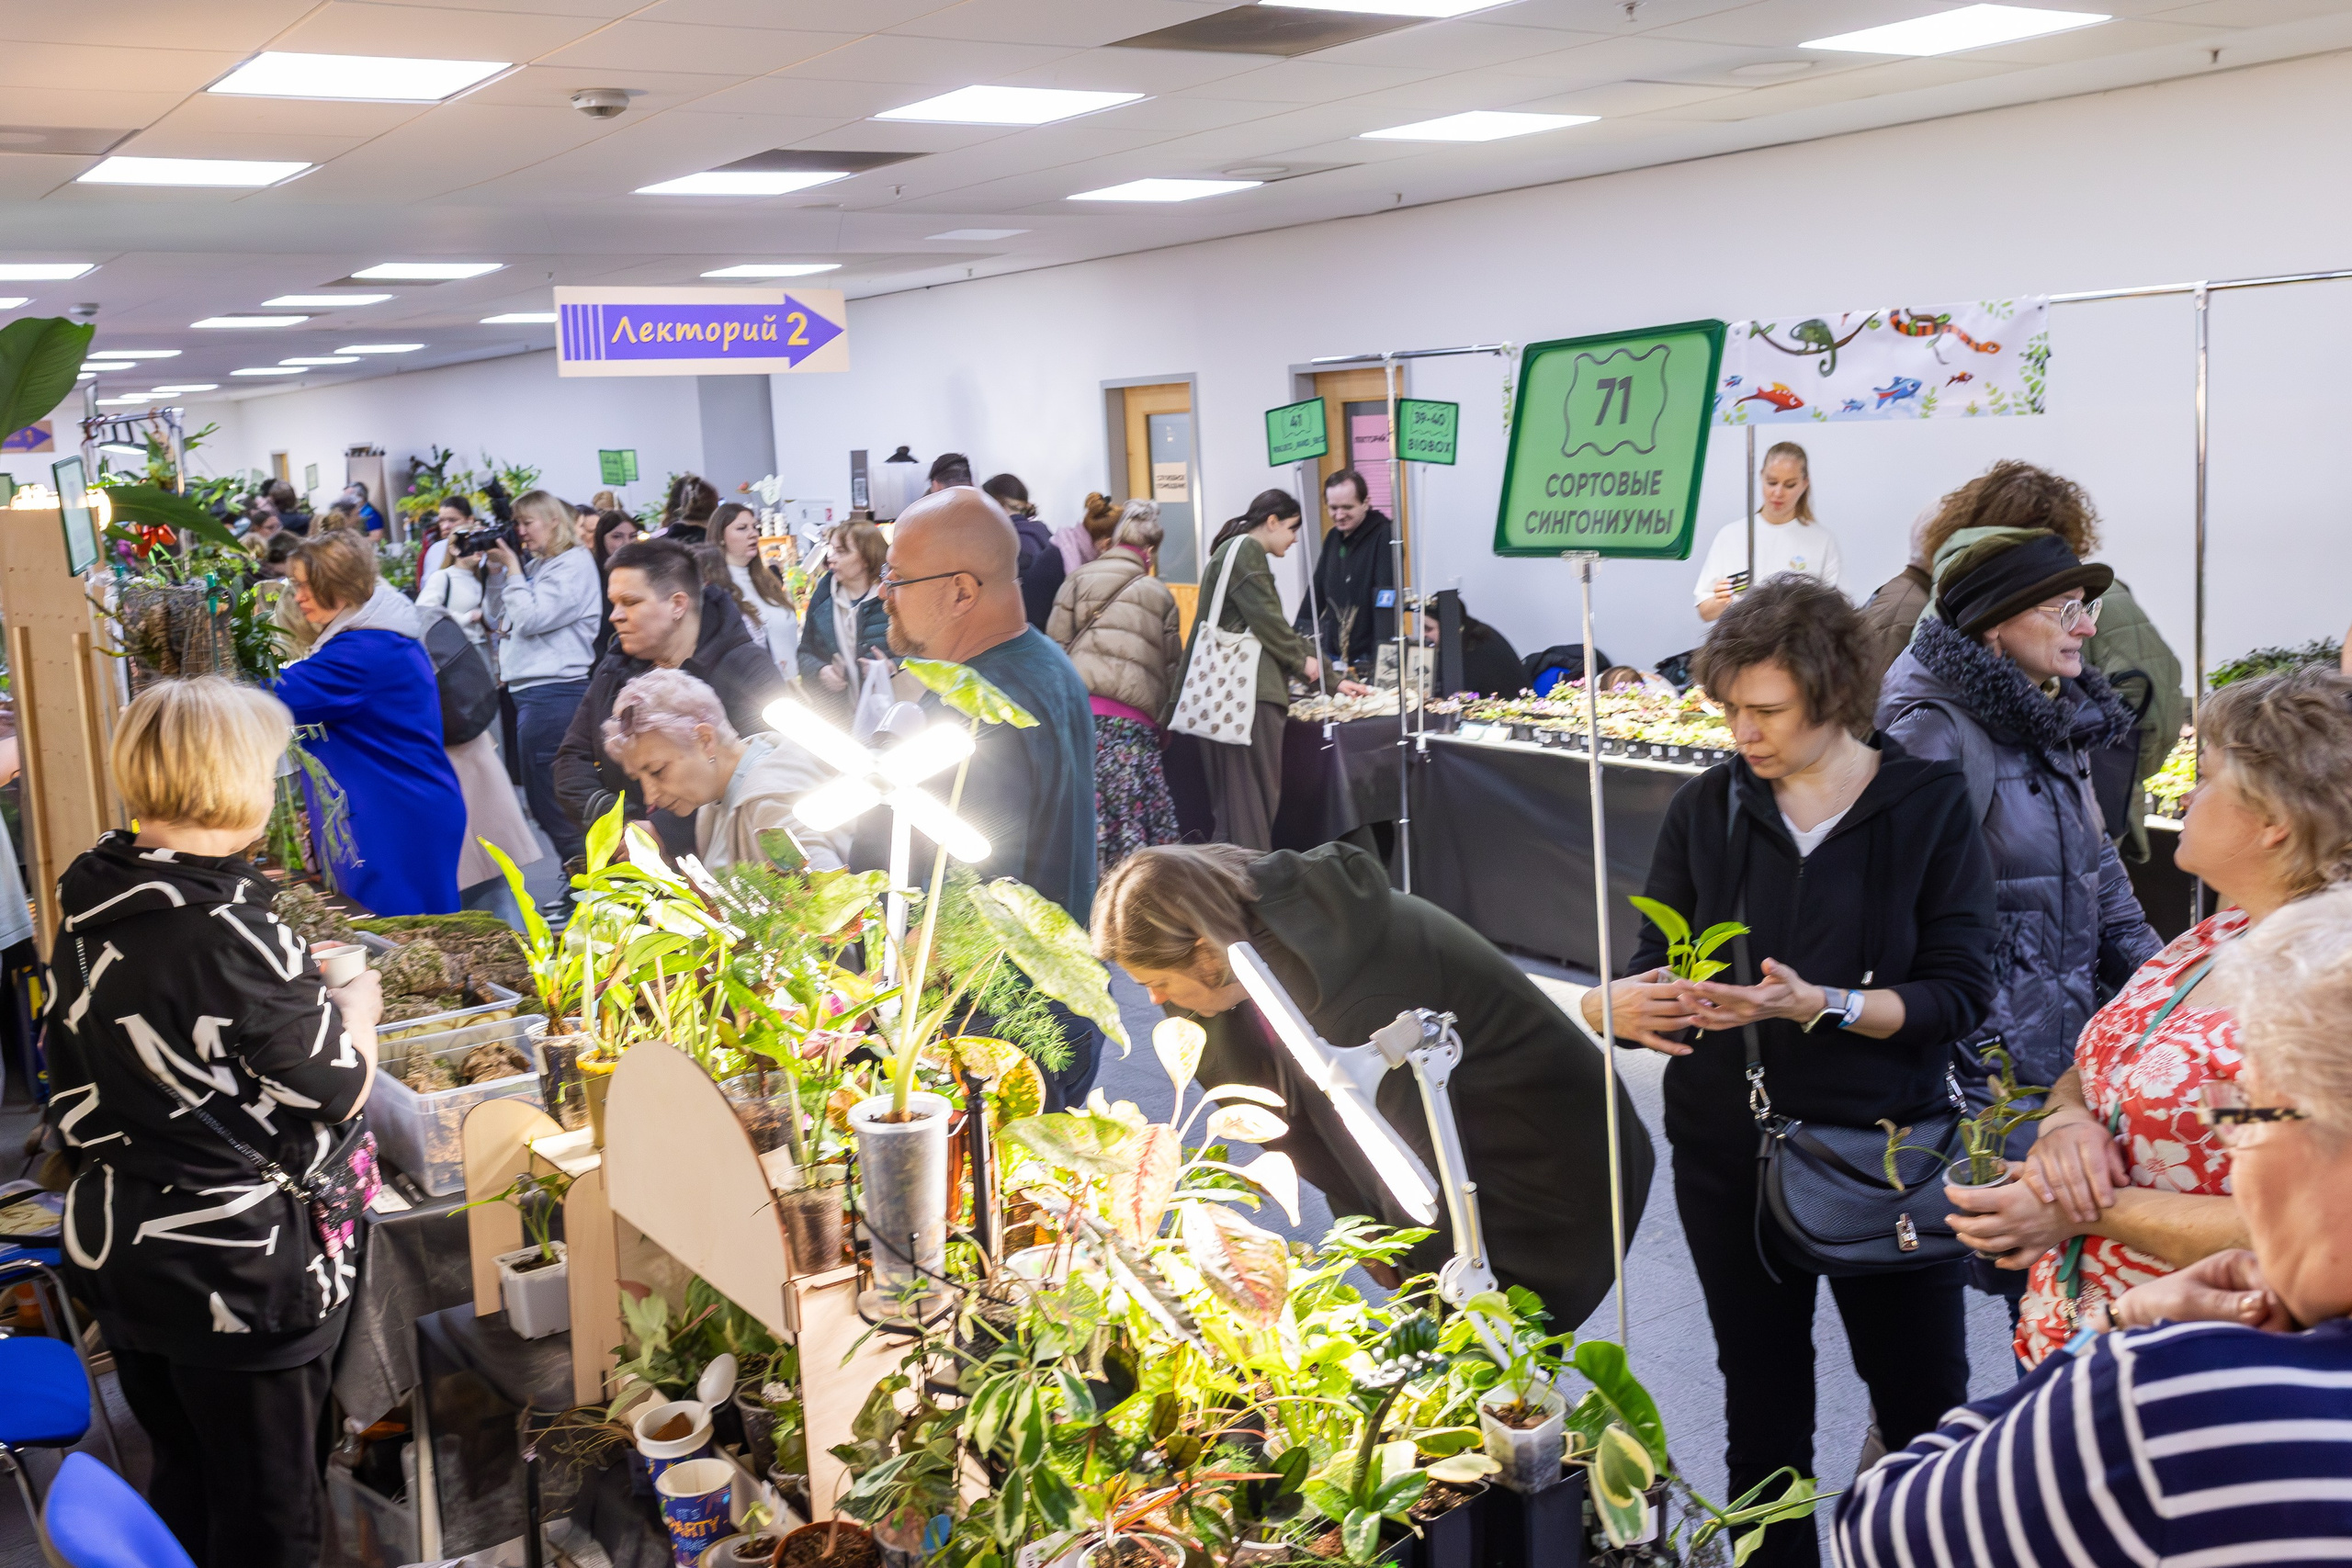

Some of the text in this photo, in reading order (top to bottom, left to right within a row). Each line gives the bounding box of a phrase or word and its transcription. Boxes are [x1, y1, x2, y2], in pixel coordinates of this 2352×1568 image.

[611, 311, 810, 352] Лекторий 2
[1595, 375, 1634, 426] 71
[1408, 437, 1452, 454] BIOBOX
[1545, 468, 1664, 498] СОРТОВЫЕ
[1524, 508, 1674, 535] СИНГОНИУМЫ
